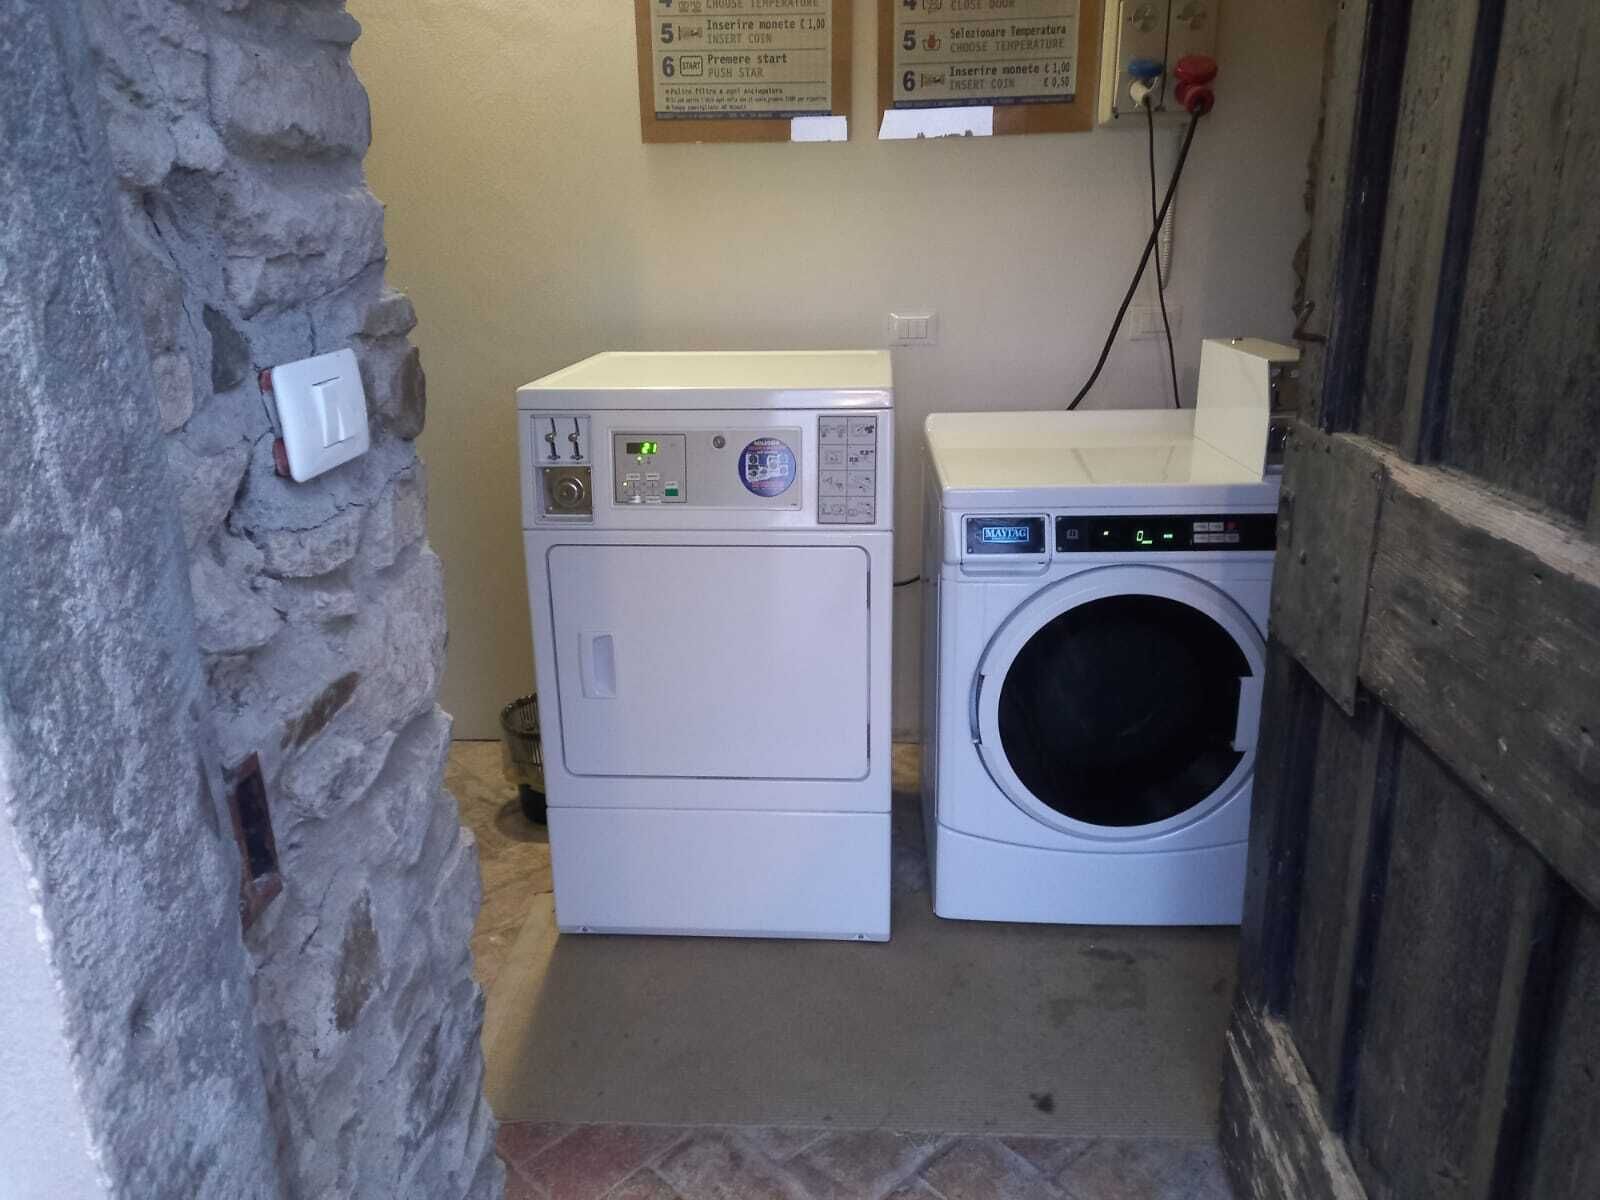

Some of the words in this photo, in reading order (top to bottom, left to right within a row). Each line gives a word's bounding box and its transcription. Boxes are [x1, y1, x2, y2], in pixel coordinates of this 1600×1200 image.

[706, 0, 744, 9] CHOOSE
[751, 0, 818, 9] TEMPERATURE
[707, 19, 754, 30] Inserire
[759, 19, 796, 30] monete
[661, 23, 674, 44] 5
[950, 27, 1006, 39] Selezionare
[1011, 25, 1066, 38] Temperatura
[707, 34, 742, 45] INSERT
[748, 34, 773, 44] COIN
[903, 30, 916, 51] 5
[950, 40, 988, 53] CHOOSE
[995, 38, 1064, 52] TEMPERATURE
[707, 55, 752, 65] Premere
[758, 53, 788, 64] start
[662, 56, 675, 78] 6
[682, 61, 701, 71] START
[950, 65, 997, 77] Inserire
[1002, 65, 1040, 75] monete
[708, 68, 733, 79] PUSH
[739, 68, 765, 78] STAR
[902, 70, 916, 91] 6
[950, 78, 984, 91] INSERT
[991, 78, 1015, 89] COIN
[984, 527, 1026, 538] MAYTAG
